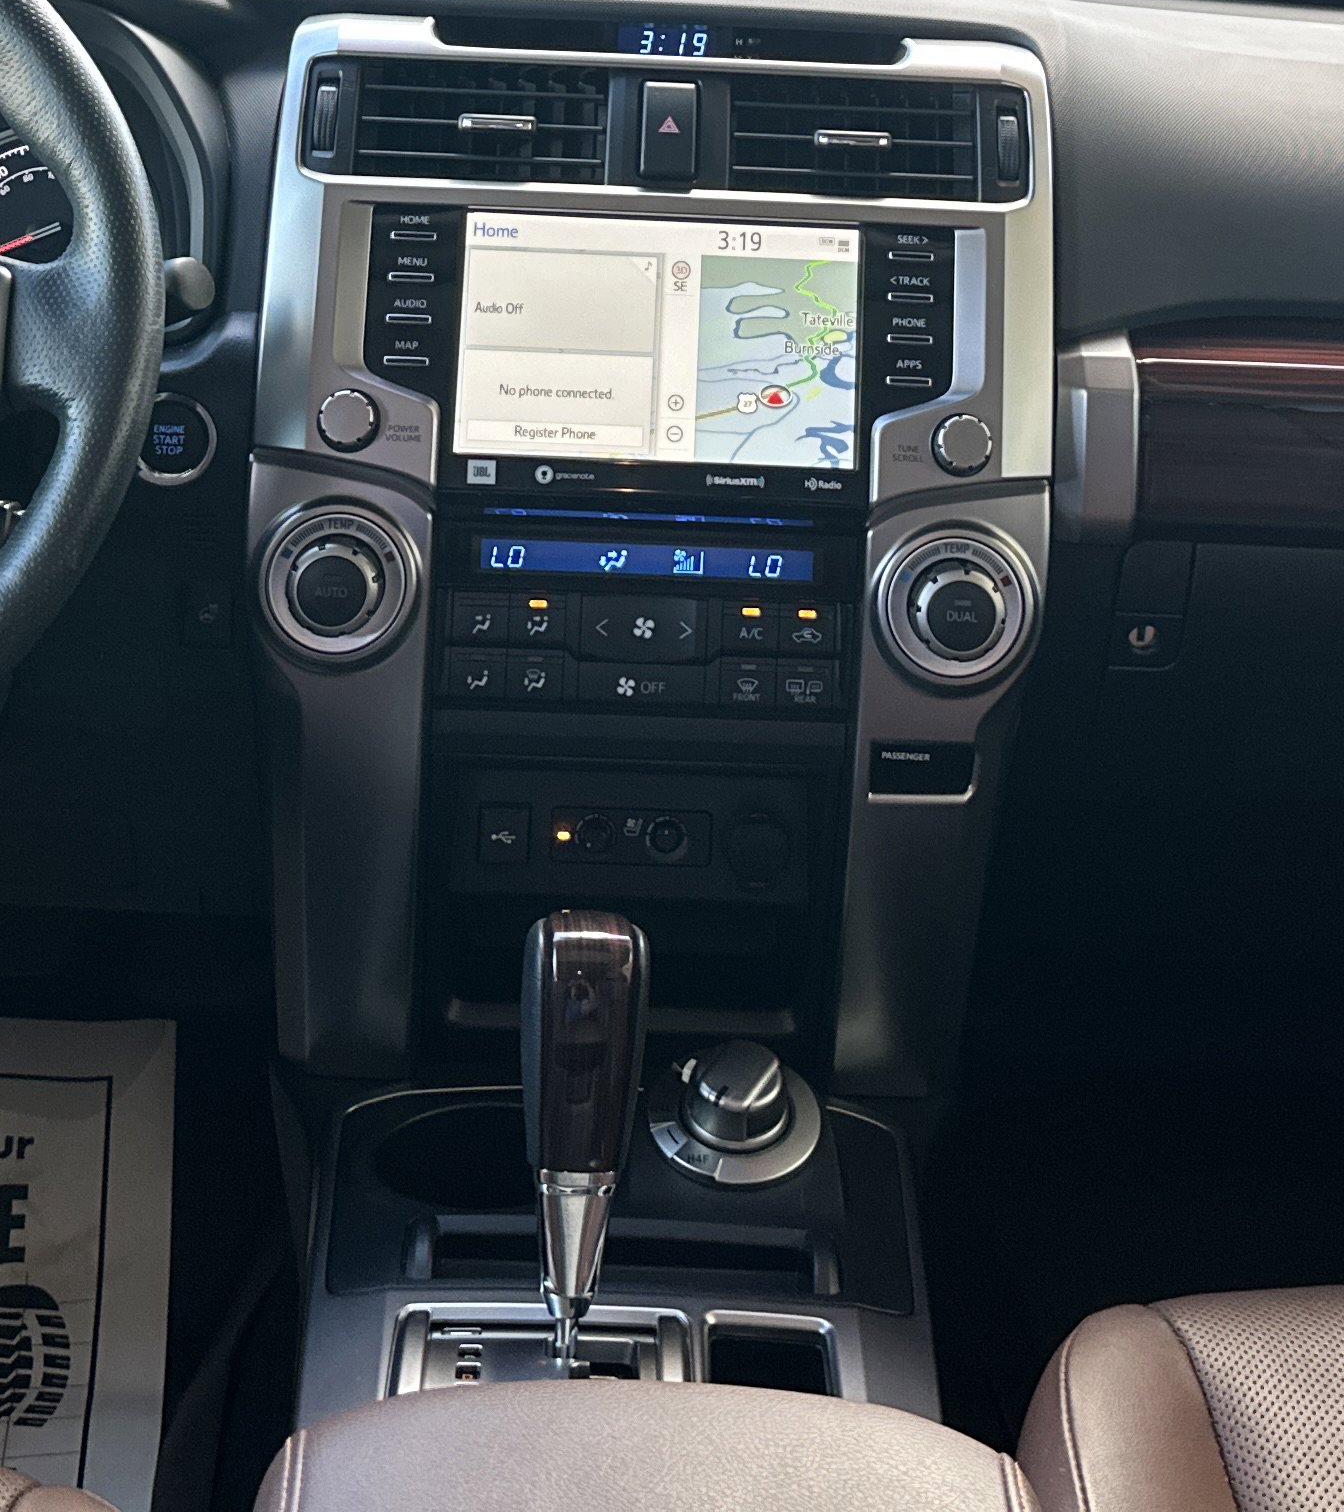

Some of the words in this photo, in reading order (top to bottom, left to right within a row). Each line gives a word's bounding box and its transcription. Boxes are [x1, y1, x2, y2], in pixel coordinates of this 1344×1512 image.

[639, 30, 707, 57] 3:19
[400, 215, 430, 225] HOME
[473, 222, 519, 238] Home
[718, 230, 762, 251] 3:19
[897, 235, 920, 244] SEEK
[397, 256, 428, 267] MENU
[674, 265, 689, 275] 3D
[673, 280, 689, 292] SE
[898, 276, 930, 286] TRACK
[393, 298, 427, 309] AUDIO
[474, 302, 503, 314] Audio
[505, 301, 525, 315] Off
[801, 311, 854, 327] Tateville
[892, 317, 927, 328] PHONE
[395, 340, 419, 351] MAP
[784, 340, 840, 356] Burnside
[896, 359, 922, 370] APPS
[499, 383, 516, 397] No
[518, 384, 553, 399] phone
[555, 386, 615, 401] connected.
[743, 400, 753, 409] 27
[153, 424, 185, 435] ENGINE
[387, 424, 420, 434] POWER
[514, 425, 559, 441] Register
[561, 426, 596, 440] Phone
[152, 434, 185, 446] START
[384, 433, 422, 443] VOLUME
[155, 445, 183, 456] STOP
[897, 445, 920, 454] TUNE
[892, 453, 924, 463] SCROLL
[472, 465, 491, 478] JBL
[555, 472, 595, 481] gracenote
[713, 475, 758, 486] SiriusXM
[818, 480, 842, 490] Radio
[327, 518, 354, 532] TEMP
[943, 543, 970, 555] TEMP
[490, 545, 526, 569] LO
[748, 554, 783, 578] LO
[314, 586, 348, 598] AUTO
[946, 610, 978, 623] DUAL
[739, 626, 764, 640] A/C
[640, 681, 666, 695] OFF
[732, 691, 761, 702] FRONT
[793, 693, 817, 704] REAR
[881, 751, 931, 761] PASSENGER
